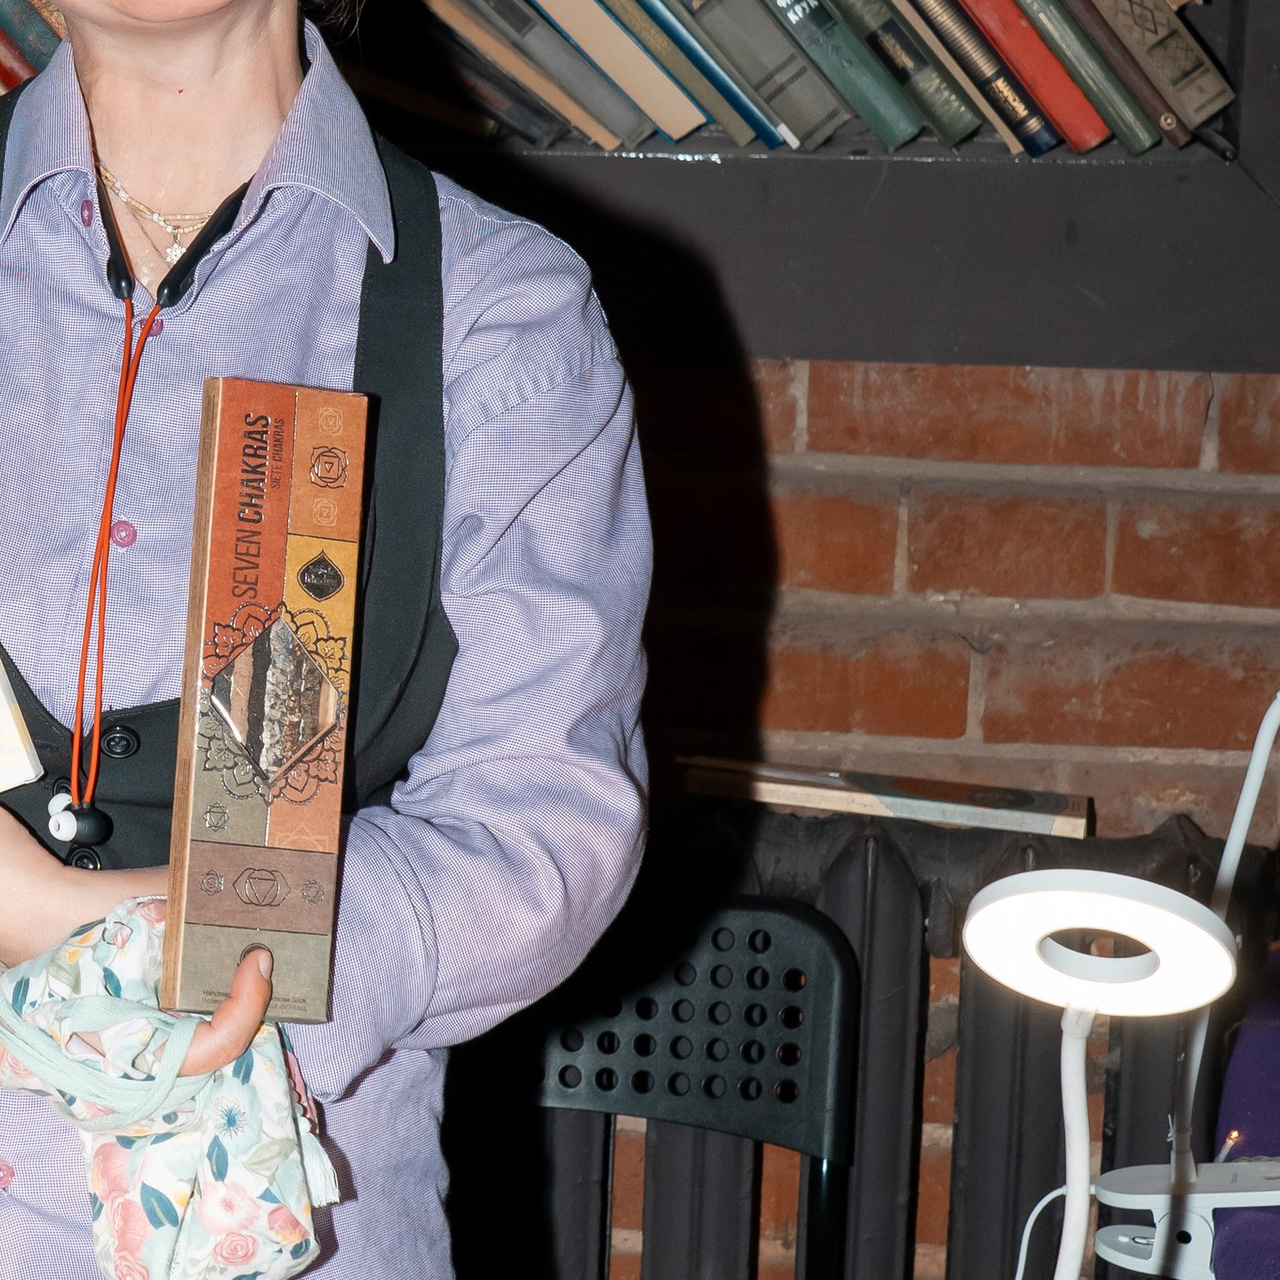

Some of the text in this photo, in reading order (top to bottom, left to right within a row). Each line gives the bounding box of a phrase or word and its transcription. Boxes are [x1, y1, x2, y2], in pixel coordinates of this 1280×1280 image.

[232, 412, 270, 599] SEVEN CHAKRAS
[271, 418, 285, 489] SIETE CHAKRAS
